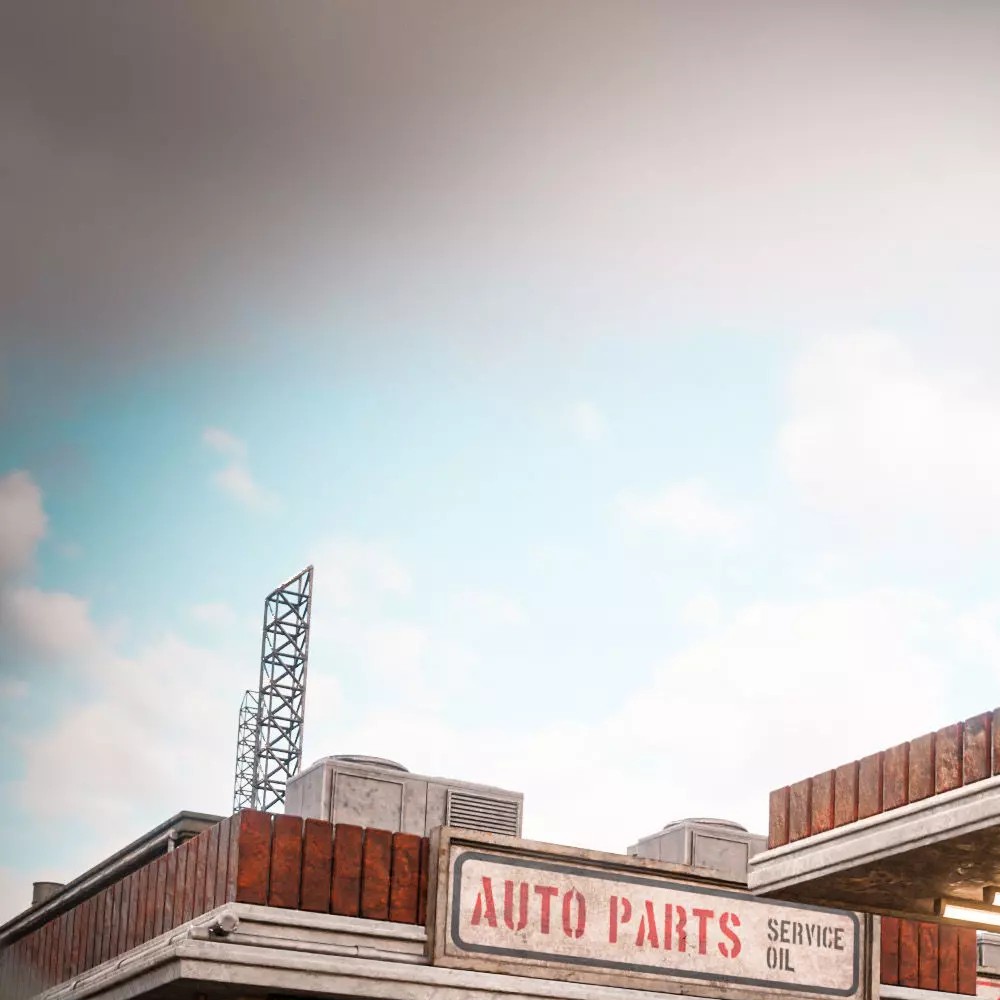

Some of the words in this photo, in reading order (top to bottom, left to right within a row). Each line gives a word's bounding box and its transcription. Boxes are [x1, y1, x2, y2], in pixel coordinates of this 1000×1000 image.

[471, 876, 587, 939] AUTO
[609, 895, 742, 959] PARTS
[767, 918, 845, 951] SERVICE
[766, 945, 795, 972] OIL
